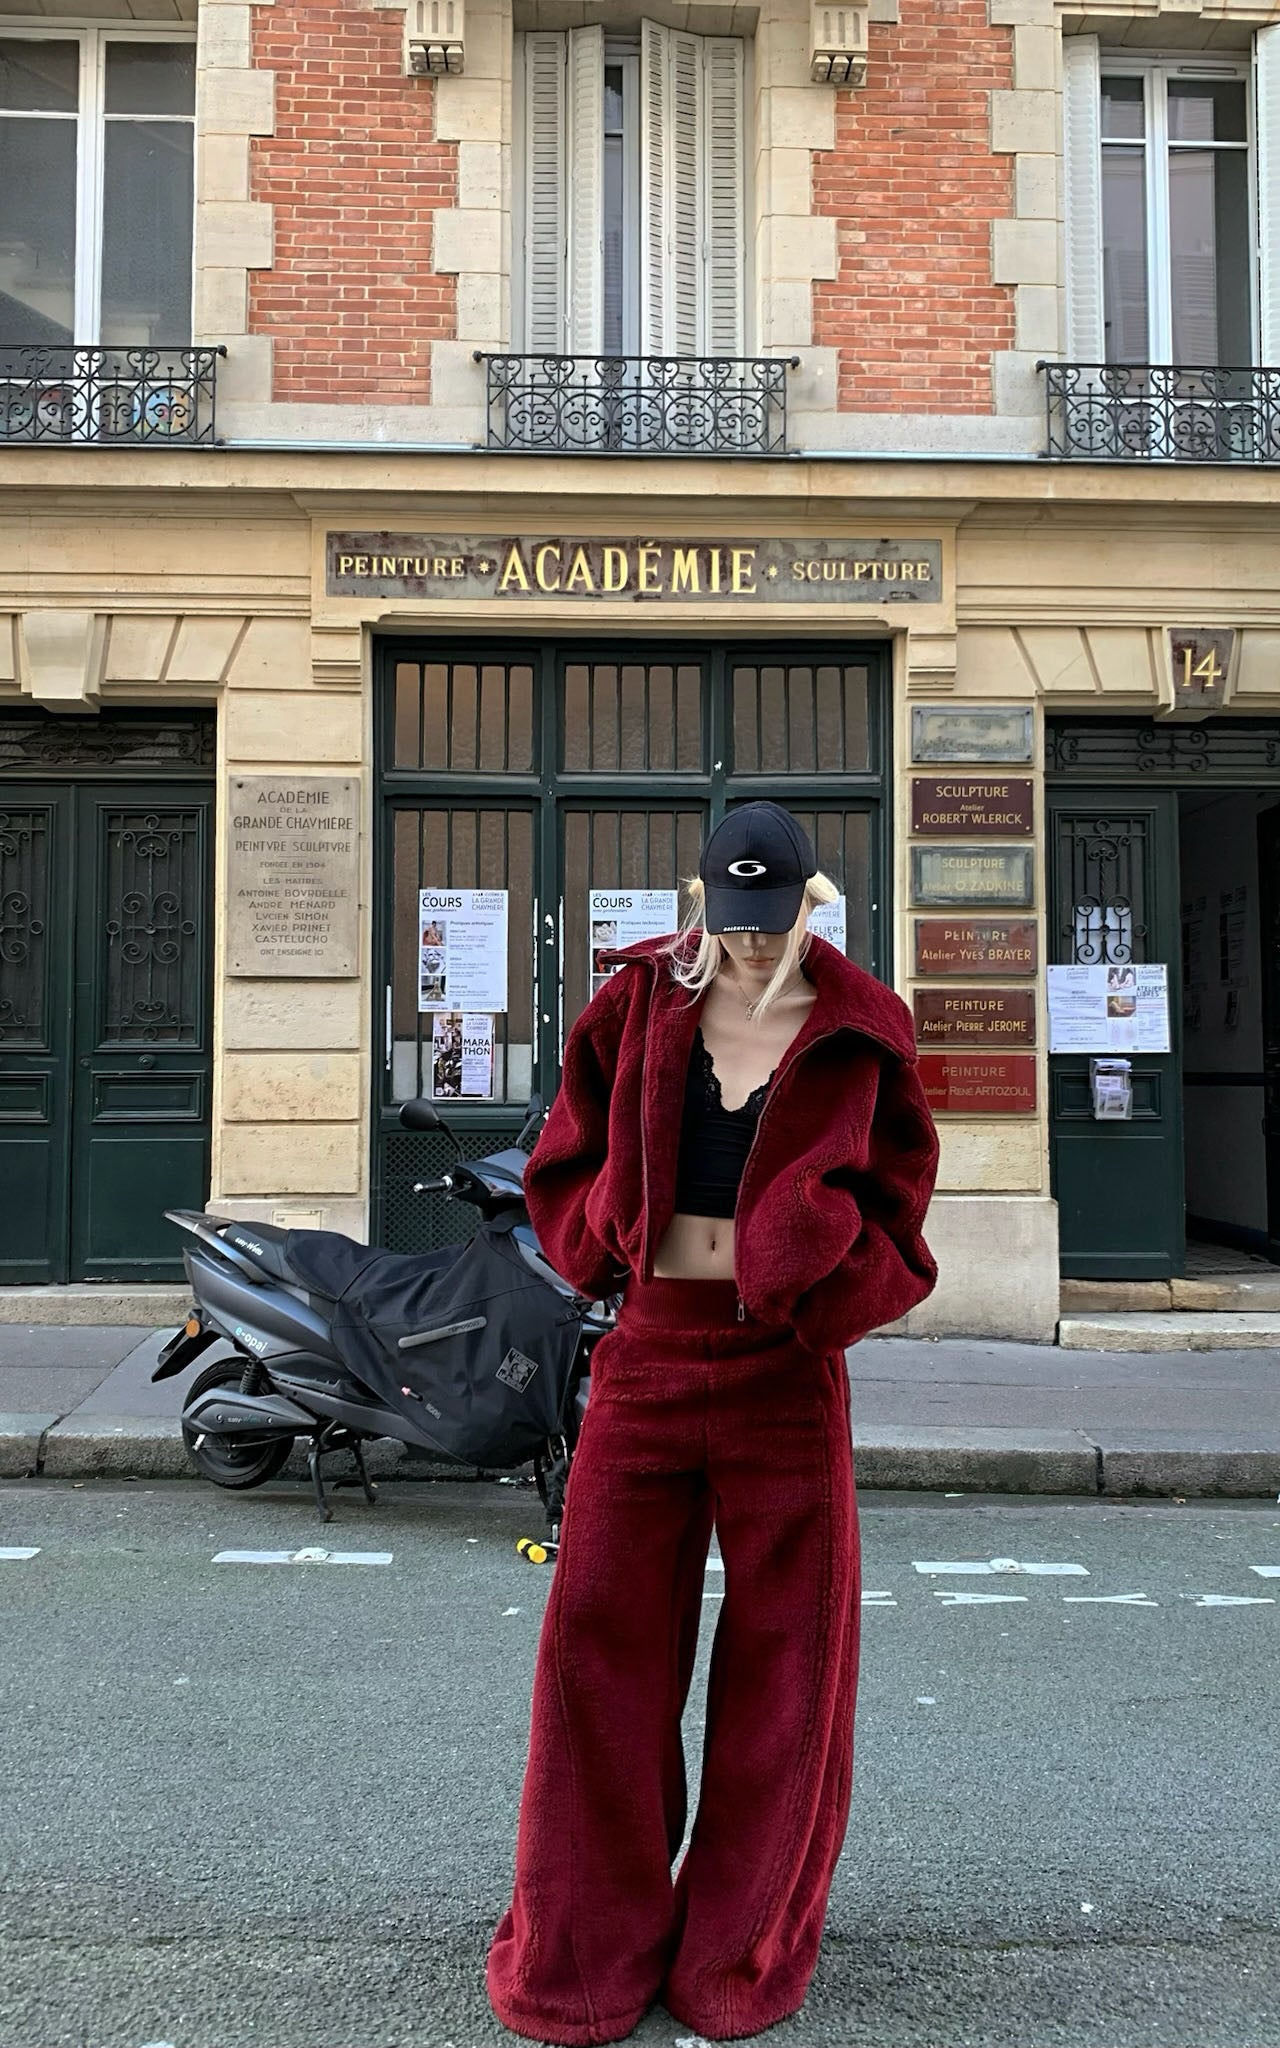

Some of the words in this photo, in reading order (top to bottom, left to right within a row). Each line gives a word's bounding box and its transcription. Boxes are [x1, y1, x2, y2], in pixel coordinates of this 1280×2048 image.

[340, 556, 465, 577] PEINTURE
[500, 541, 757, 594] ACADÉMIE
[793, 561, 930, 581] SCULPTURE
[1182, 647, 1222, 687] 14
[257, 791, 331, 804] ACADÉMIE
[935, 786, 1009, 798] SCULPTURE
[960, 803, 985, 812] Atelier
[233, 816, 283, 830] GRANDE
[922, 813, 969, 825] ROBERT
[971, 813, 1023, 825] WLERICK
[236, 840, 287, 852] PEINTVRE
[292, 841, 352, 853] SCULPTVRE
[942, 858, 1006, 869] SCULPTURE
[237, 889, 281, 898] ANTOINE
[285, 889, 349, 899] BOVRDELLE
[423, 897, 463, 908] COURS
[593, 897, 633, 908] COURS
[256, 912, 289, 921] LVCIEN
[293, 912, 329, 921] SIMON
[292, 923, 332, 933] PRINET
[255, 935, 329, 944] CASTELUCHO
[921, 949, 956, 961] Atelier
[988, 949, 1032, 961] BRAYER
[944, 1000, 1005, 1011] PEINTURE
[922, 1020, 953, 1032] Atelier
[987, 1020, 1027, 1032] JEROME
[463, 1038, 491, 1047] MARA
[463, 1047, 491, 1055] THON
[942, 1066, 1006, 1077] PEINTURE
[974, 1085, 1032, 1097] ARTOZOUL
[235, 1327, 268, 1353] e-opal
